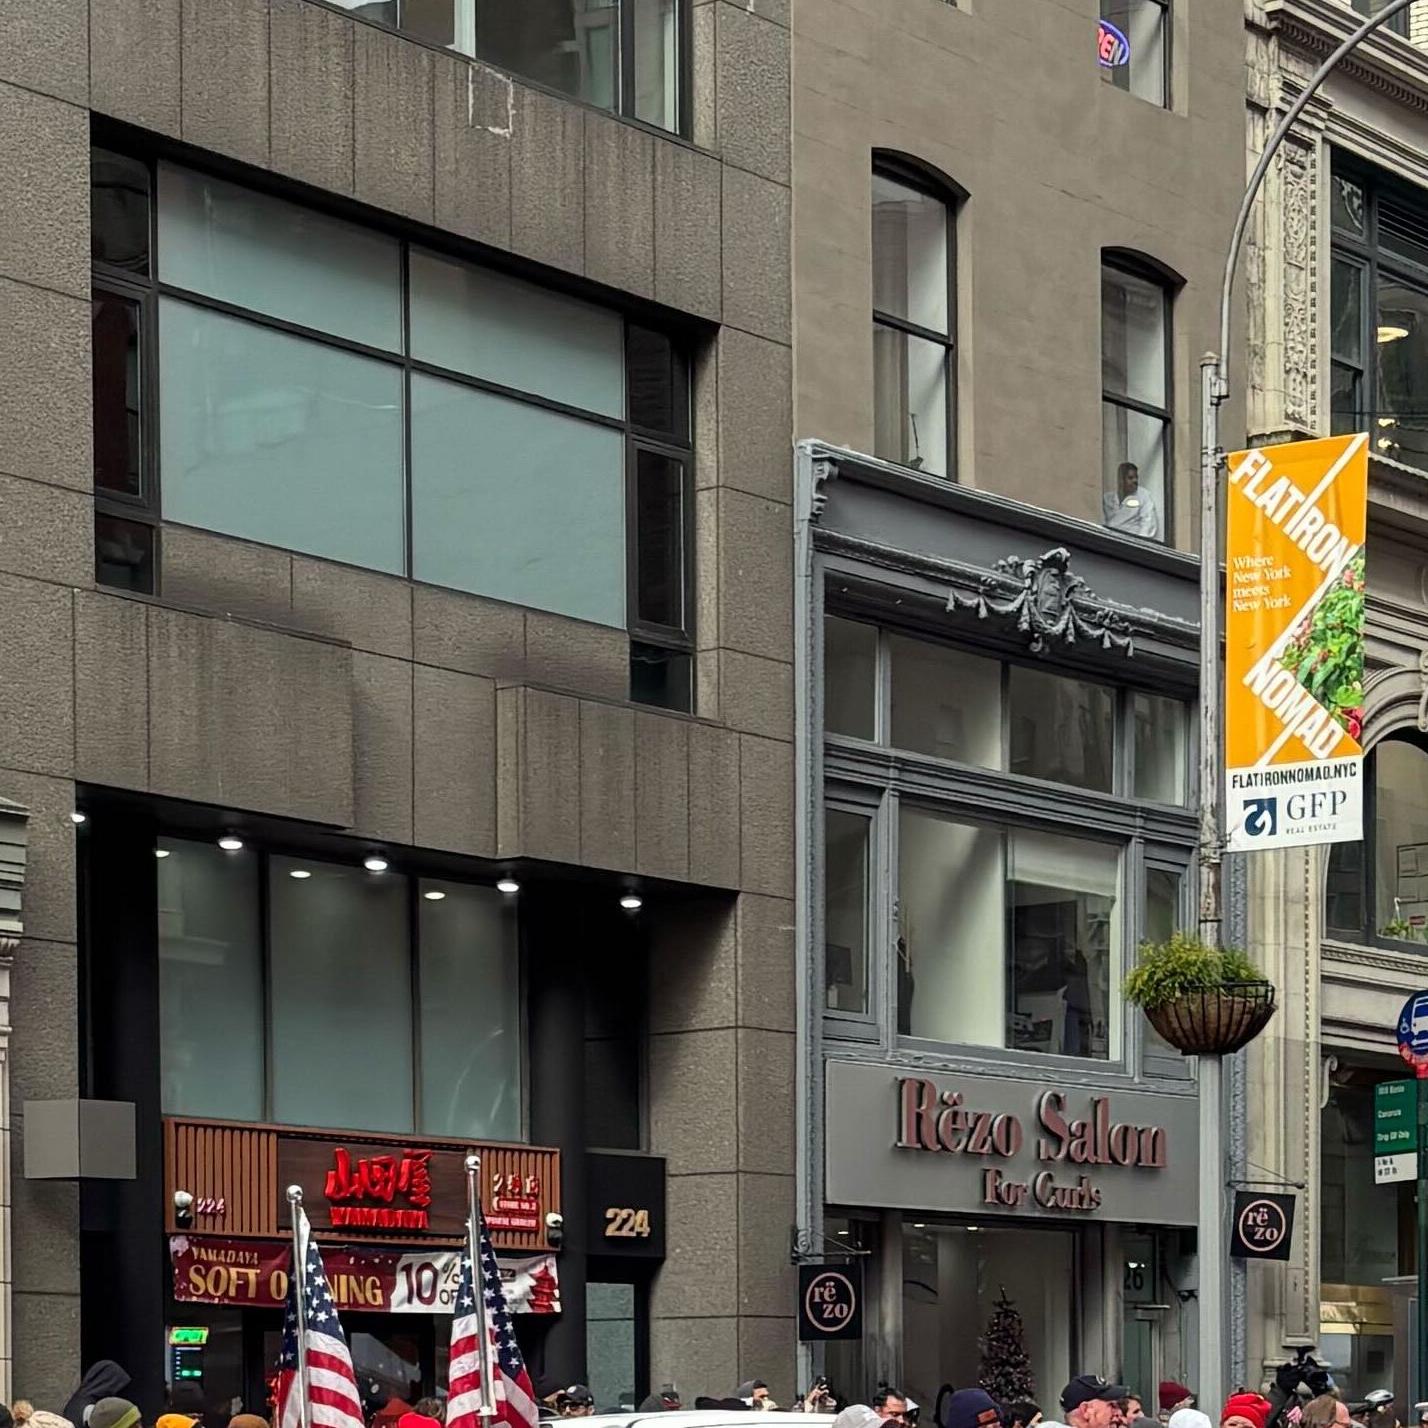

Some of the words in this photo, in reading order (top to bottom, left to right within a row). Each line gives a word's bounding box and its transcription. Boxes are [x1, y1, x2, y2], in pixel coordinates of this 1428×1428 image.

[1229, 450, 1359, 572] FLATIRON
[1233, 556, 1274, 570] Where
[1233, 571, 1261, 583] New
[1263, 565, 1292, 580] York
[1233, 586, 1270, 598] meets
[1233, 600, 1260, 612] New
[1263, 595, 1292, 609] York
[1242, 656, 1344, 759] NOMAD
[1232, 762, 1357, 789] FLATIRONNOMAD.NYC
[1286, 790, 1347, 820] GFP
[896, 1077, 1024, 1158] Rëzo
[1037, 1090, 1167, 1167] Salon
[983, 1167, 1028, 1206] For
[1034, 1171, 1102, 1210] Curls
[605, 1207, 651, 1237] 224
[1247, 1207, 1269, 1226] rë
[1253, 1227, 1279, 1241] zo
[192, 1246, 258, 1265] YAMADAYA
[189, 1264, 261, 1298] SOFT
[270, 1270, 383, 1306] ONING
[813, 1281, 837, 1302] rë
[439, 1288, 458, 1306] OF
[822, 1303, 849, 1319] zo
